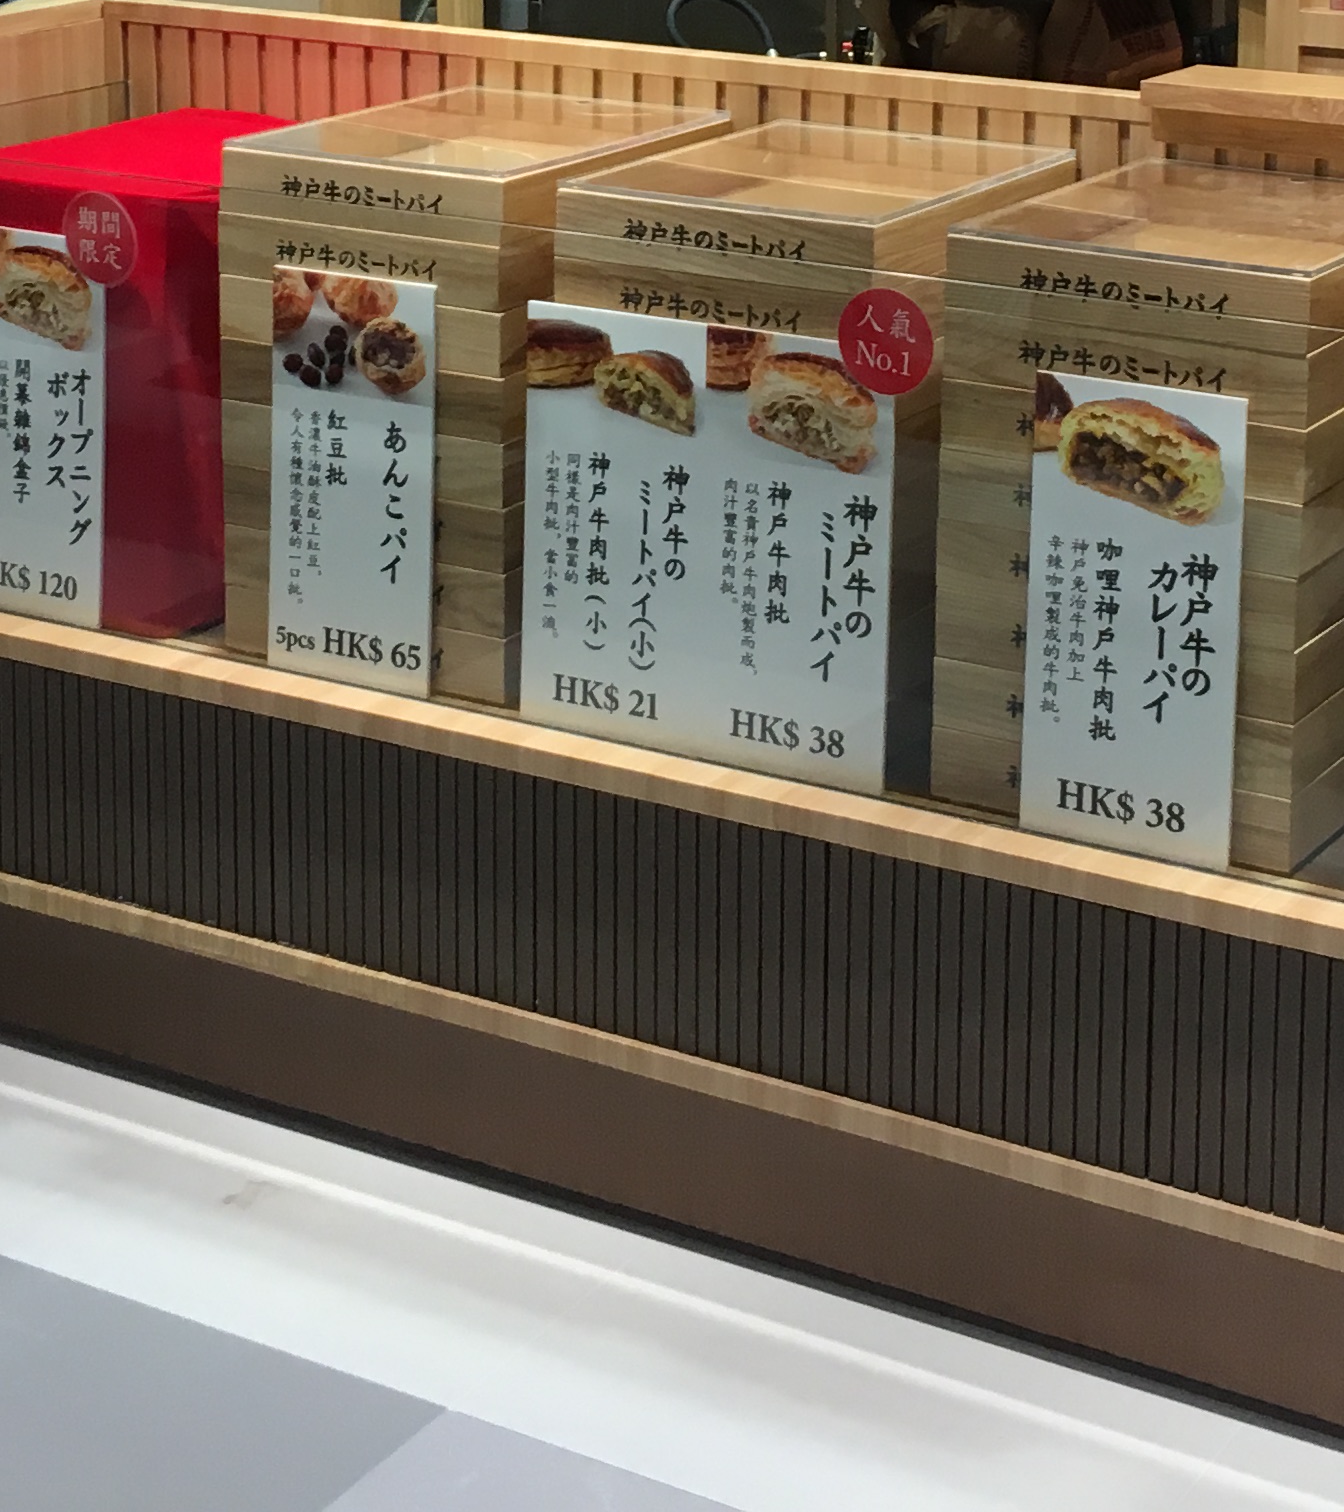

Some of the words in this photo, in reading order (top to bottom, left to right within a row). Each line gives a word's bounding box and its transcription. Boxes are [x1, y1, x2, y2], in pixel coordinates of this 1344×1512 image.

[77, 206, 121, 239] 期間
[79, 239, 122, 270] 限定
[856, 303, 916, 345] 人氣
[855, 339, 912, 378] No.1
[46, 371, 69, 488] ボックス
[325, 409, 348, 486] 紅豆批
[69, 368, 94, 545] オープニング
[380, 421, 408, 584] あんこパイ
[39, 570, 78, 601] 120
[810, 512, 842, 683] ミートパイ
[276, 625, 315, 653] 5pcs
[322, 626, 383, 665] HK$
[391, 642, 421, 671] 65
[1142, 561, 1179, 724] カレーパイ
[552, 672, 619, 715] HK$
[628, 689, 659, 721] 21
[729, 707, 800, 750] HK$
[809, 725, 845, 759] 38
[1056, 777, 1135, 824] HK$
[1145, 798, 1186, 834] 38
